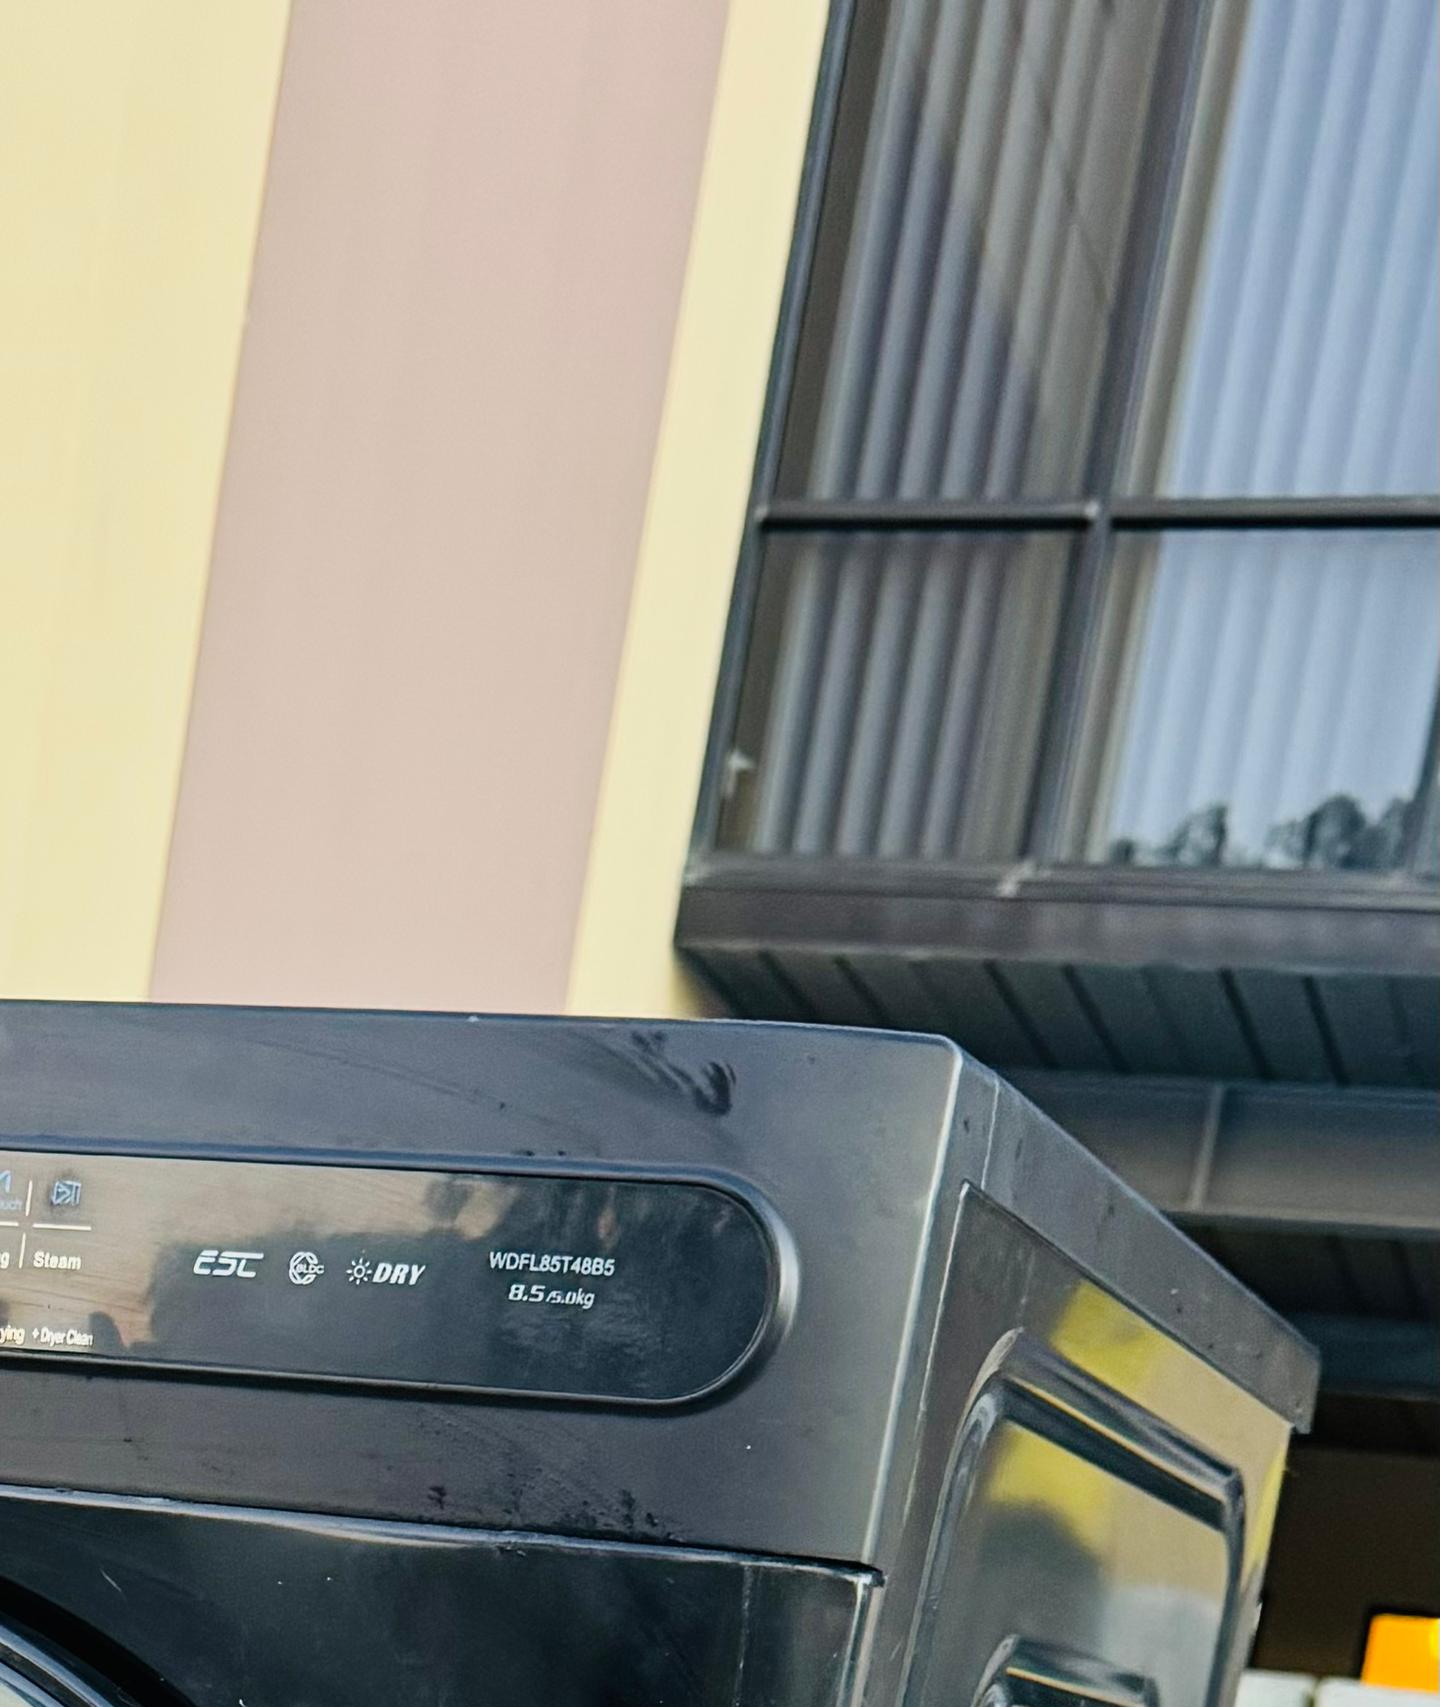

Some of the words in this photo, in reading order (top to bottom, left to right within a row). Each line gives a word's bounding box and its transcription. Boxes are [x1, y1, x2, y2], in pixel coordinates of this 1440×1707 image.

[33, 1250, 82, 1271] Steam
[489, 1251, 616, 1277] WDFL85T48B5
[372, 1263, 426, 1286] DRY
[40, 1327, 66, 1347] Dryer
[66, 1329, 94, 1346] Clean
